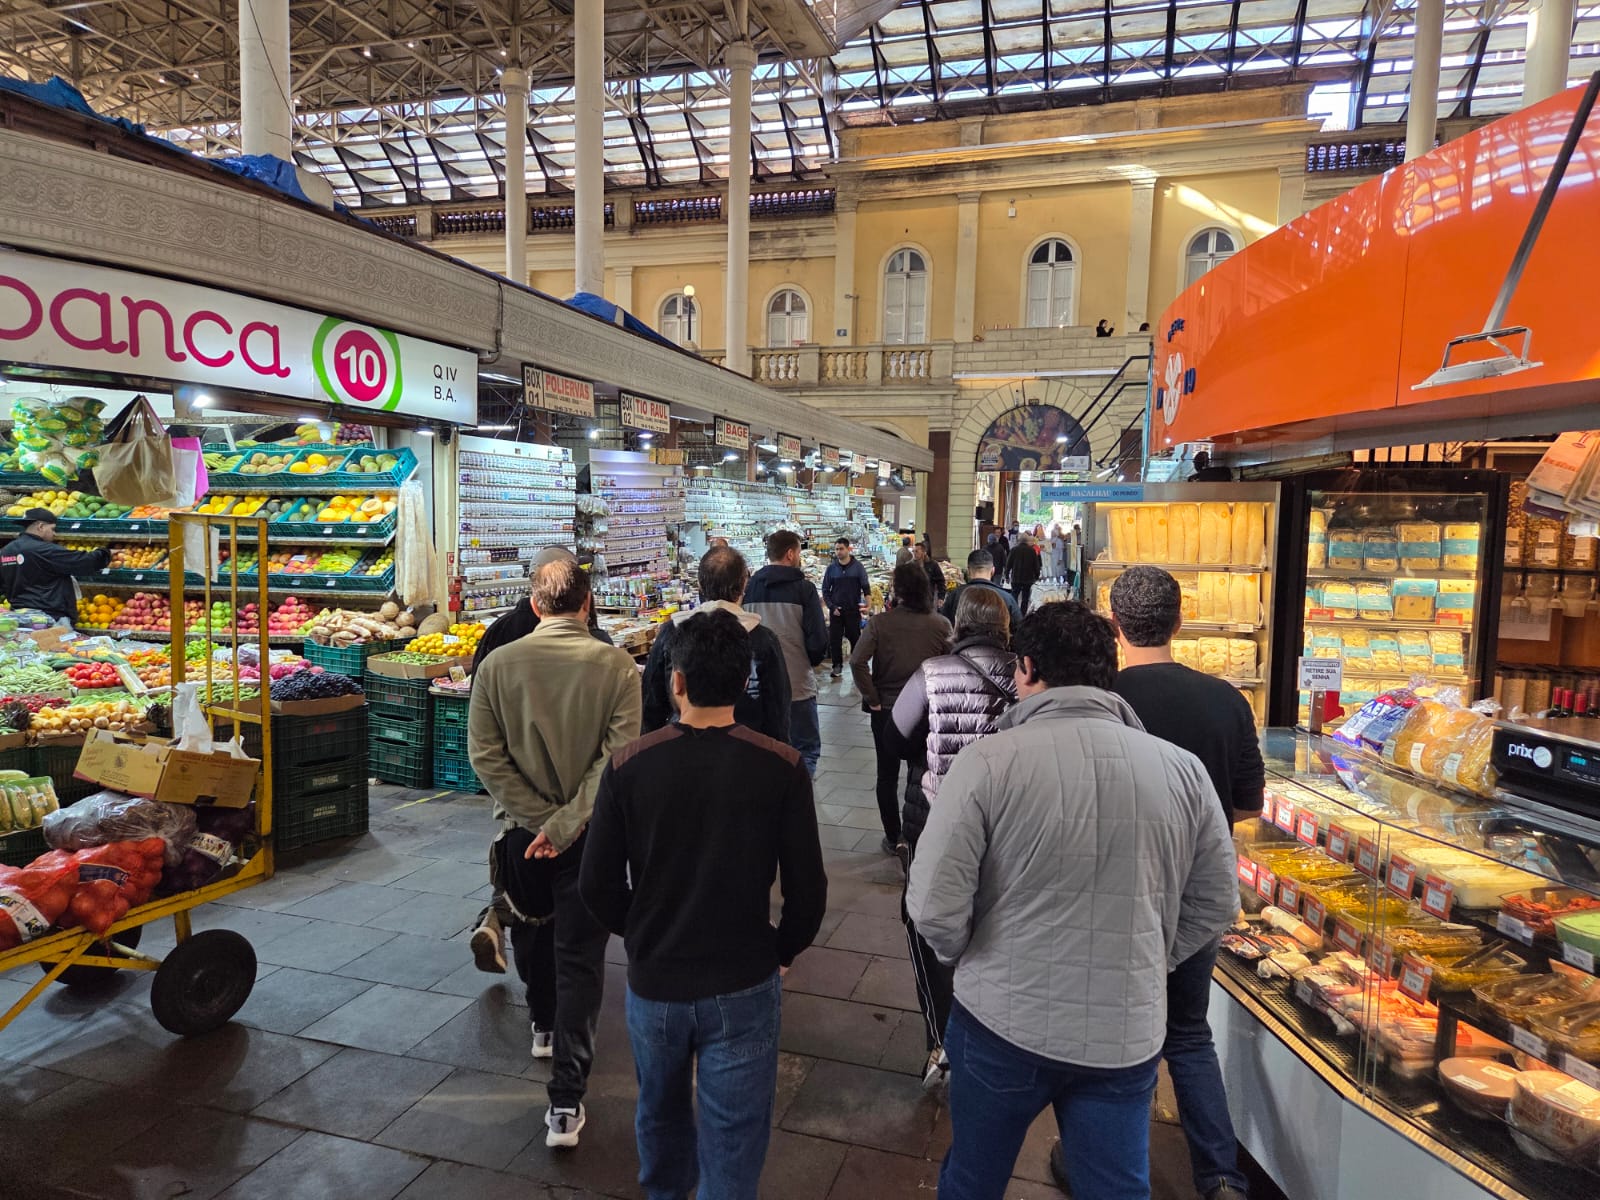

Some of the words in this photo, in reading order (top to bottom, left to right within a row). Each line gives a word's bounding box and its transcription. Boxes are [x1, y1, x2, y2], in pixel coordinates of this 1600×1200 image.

[340, 344, 381, 389] 10
[433, 364, 445, 382] Q
[446, 366, 457, 383] IV
[525, 369, 541, 389] BOX
[545, 374, 590, 401] POLIERVAS
[434, 386, 457, 403] B.A.
[528, 391, 540, 406] 01
[621, 395, 633, 413] BOX
[635, 399, 648, 416] TIO
[650, 402, 668, 419] RAUL
[623, 412, 632, 425] 02
[726, 423, 748, 439] BAGE
[1071, 489, 1111, 497] BACALHAU
[1508, 743, 1533, 760] prix
